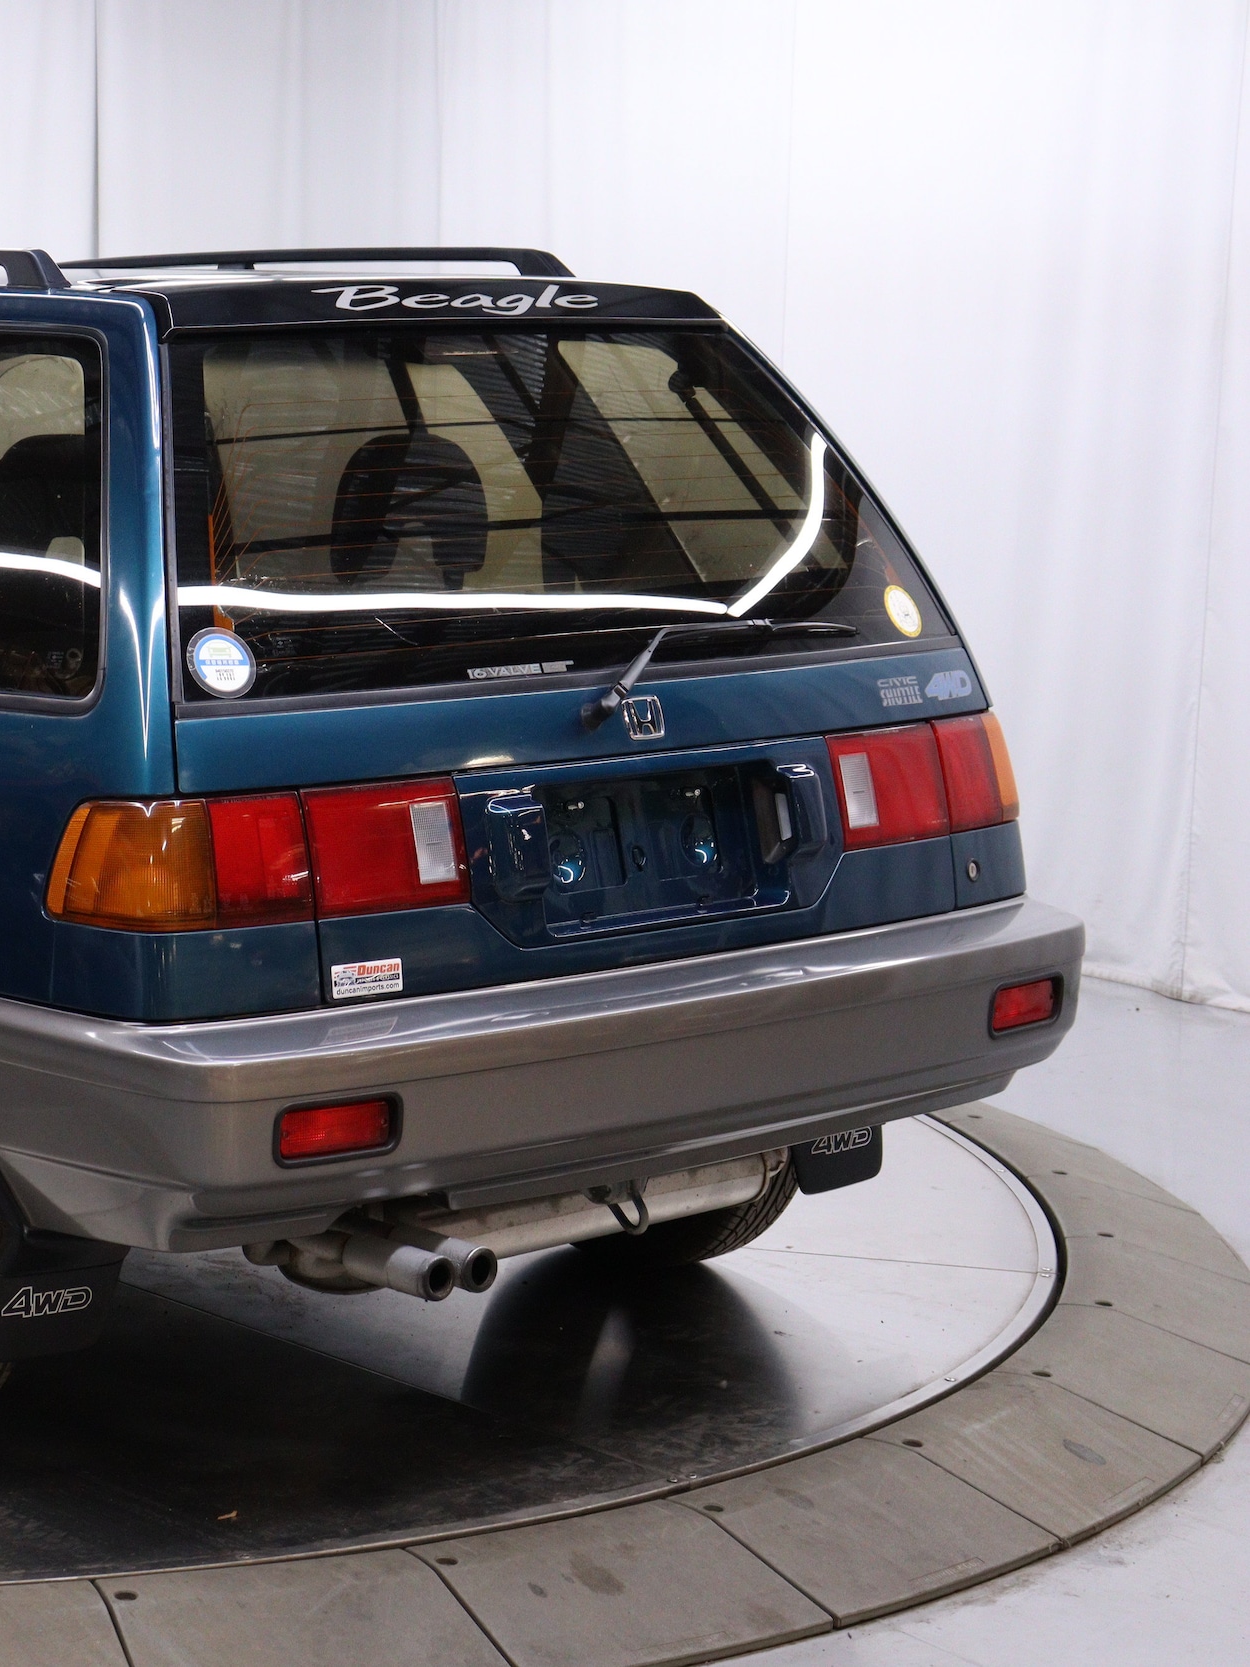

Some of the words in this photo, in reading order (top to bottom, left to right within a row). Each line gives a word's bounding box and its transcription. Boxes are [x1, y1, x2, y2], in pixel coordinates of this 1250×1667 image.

[311, 285, 599, 315] Beagle
[877, 676, 918, 687] CIVIC
[925, 670, 972, 701] 4WD
[880, 686, 923, 707] SHUTTLE
[357, 963, 400, 976] Duncan
[336, 982, 400, 995] duncanimports.com
[811, 1126, 873, 1154] 4WD
[1, 1286, 92, 1318] 4WD
